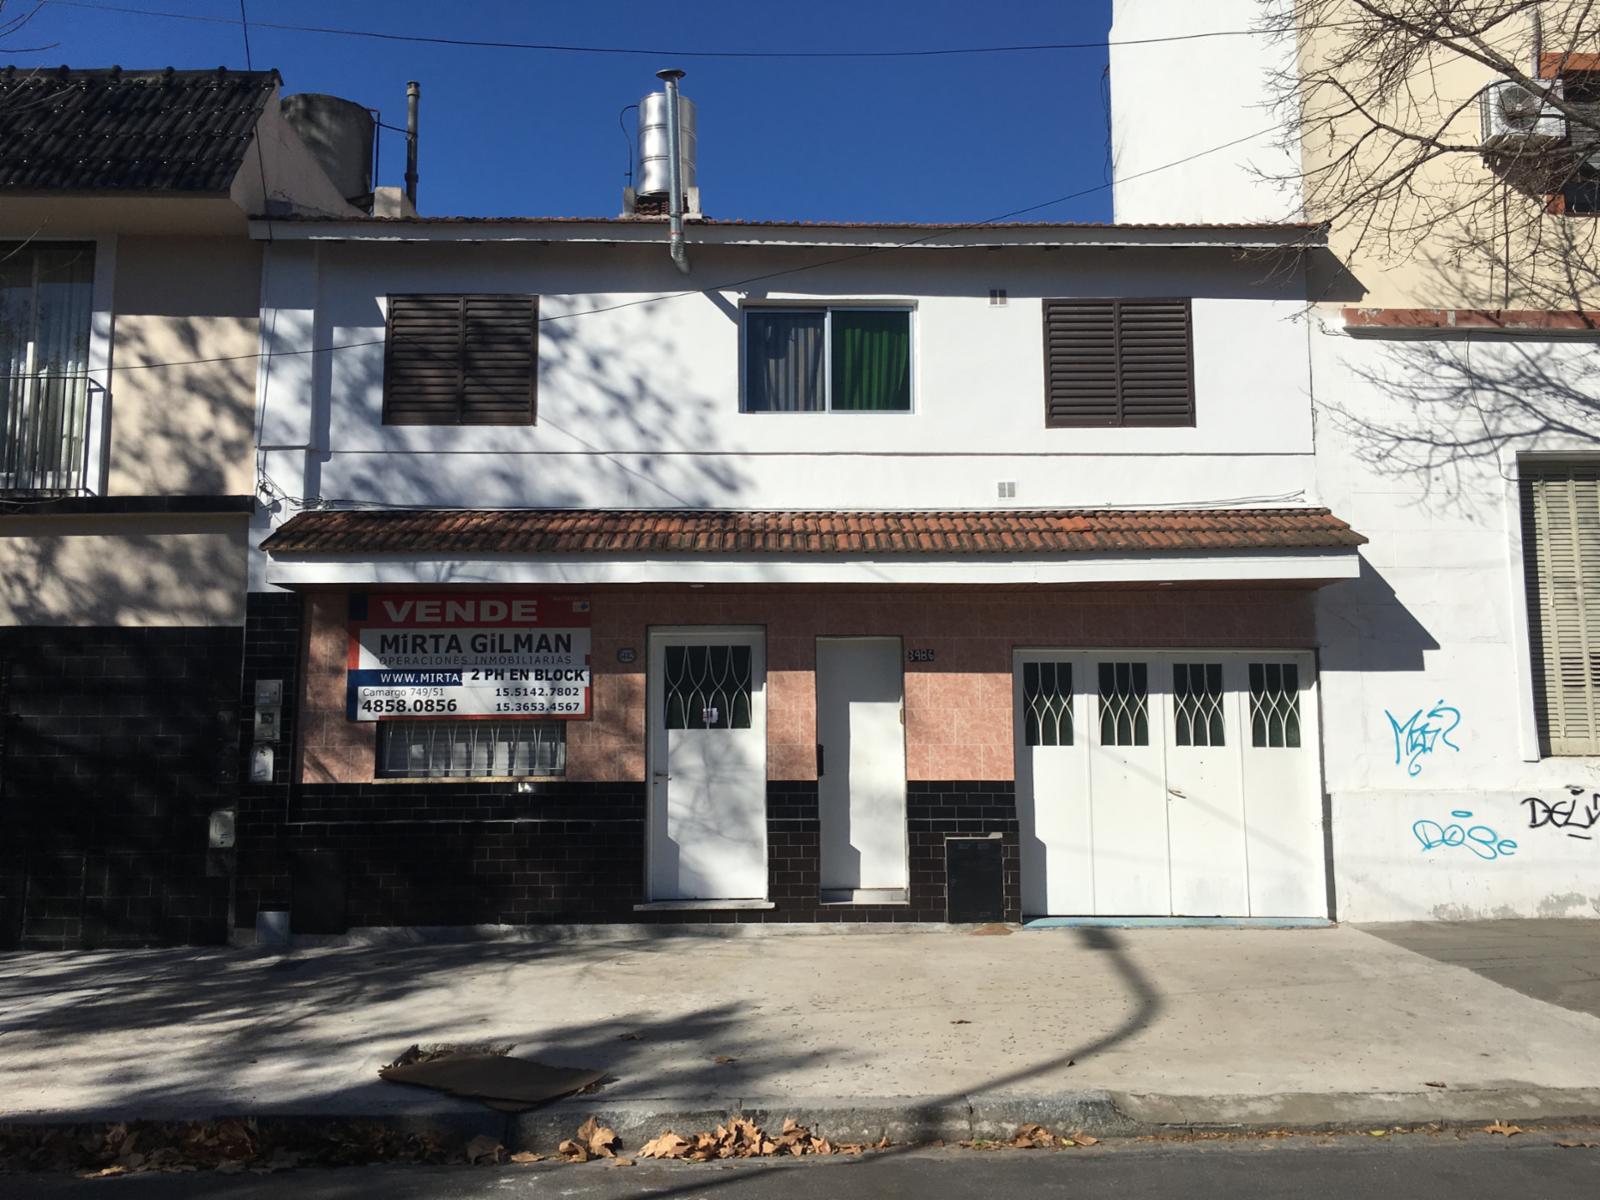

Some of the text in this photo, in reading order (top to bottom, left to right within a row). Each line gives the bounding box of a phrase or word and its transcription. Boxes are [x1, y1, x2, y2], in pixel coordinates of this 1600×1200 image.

[381, 600, 539, 623] VENDE
[379, 655, 572, 665] OPERACIONES INMOBILIARIAS
[471, 669, 585, 681] 2 PH EN BLOCK
[362, 687, 445, 698] Camargo 749/51
[496, 687, 579, 697] 15.5142.7802
[362, 699, 458, 712] 4858.0856
[496, 702, 580, 711] 15.3653.4567
